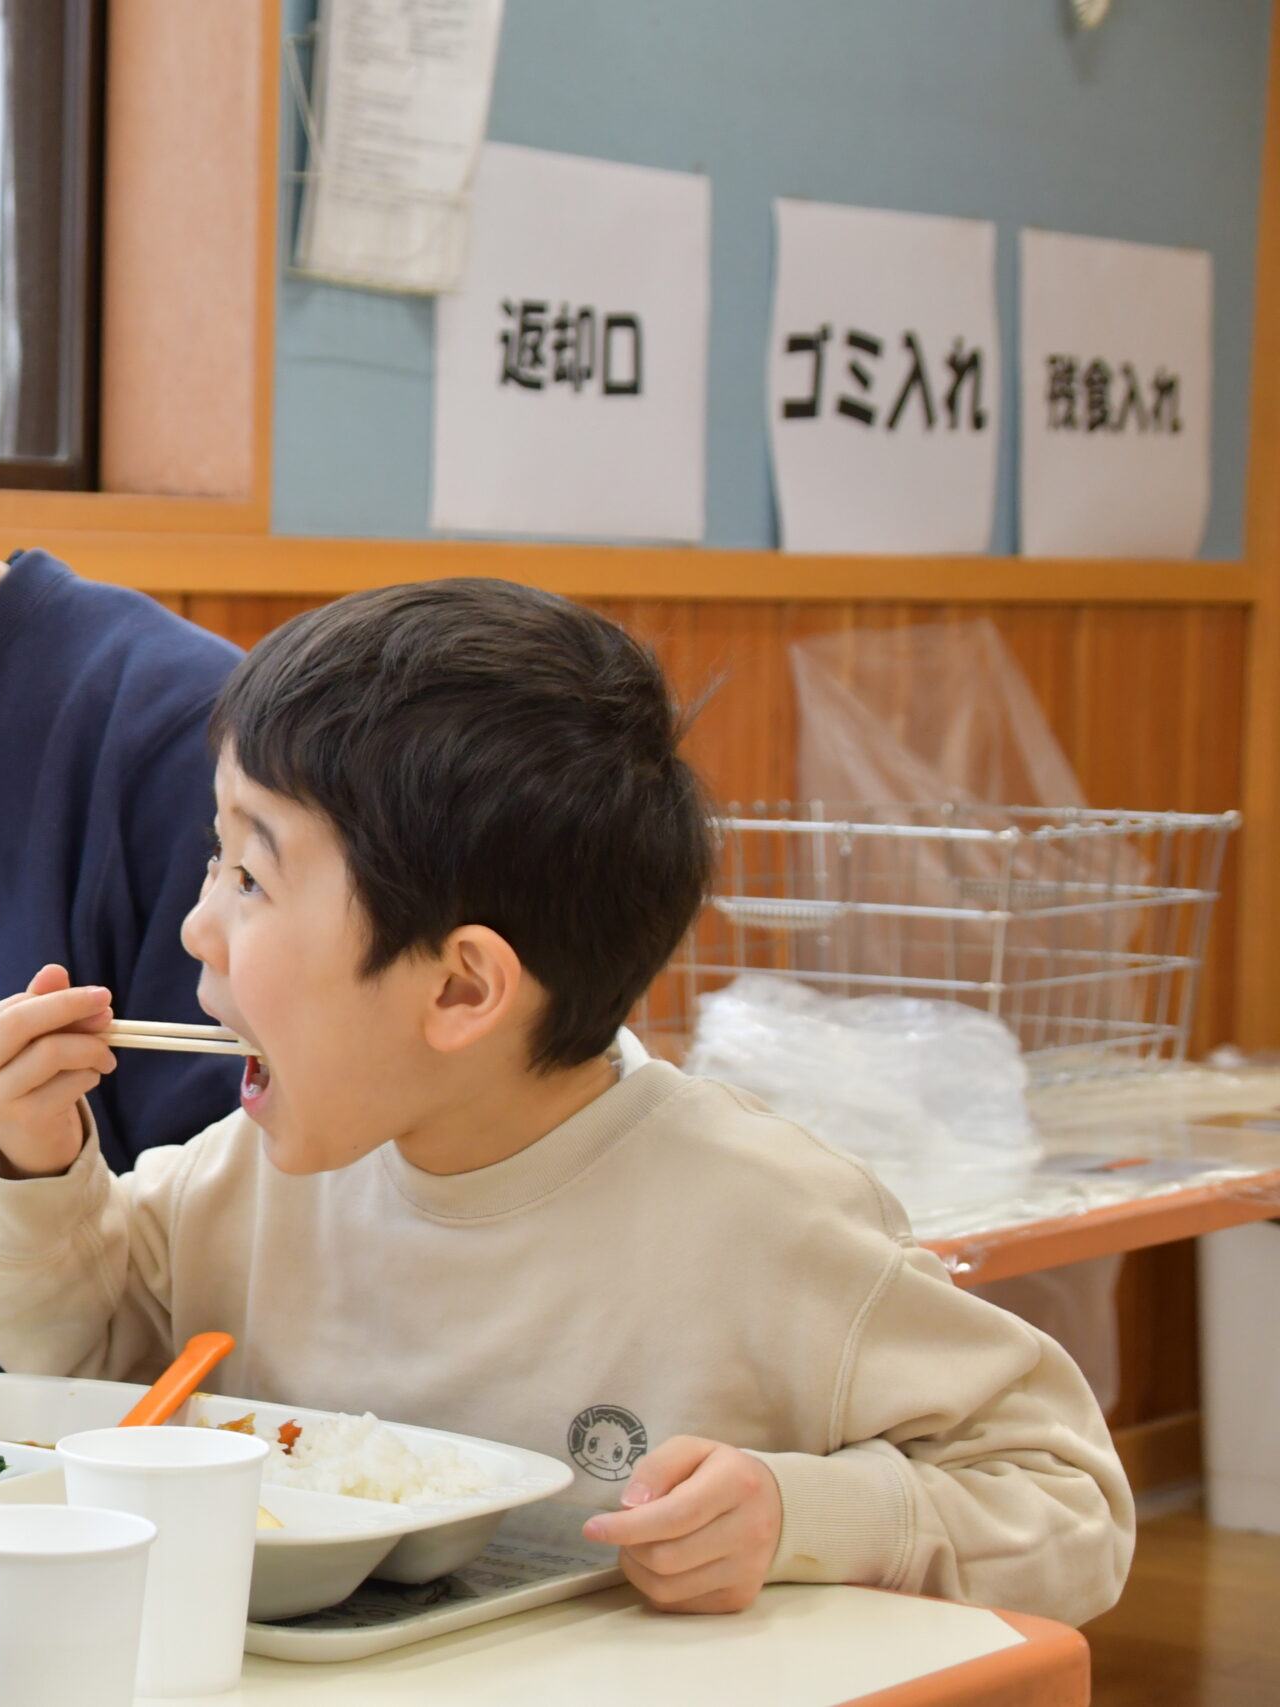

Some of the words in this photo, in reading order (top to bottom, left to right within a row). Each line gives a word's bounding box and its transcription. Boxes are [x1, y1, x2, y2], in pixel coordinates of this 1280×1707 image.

[500, 300, 641, 396] 返却口
[781, 322, 987, 432] ゴミ入れ
[1046, 353, 1182, 435] 残食入れ
